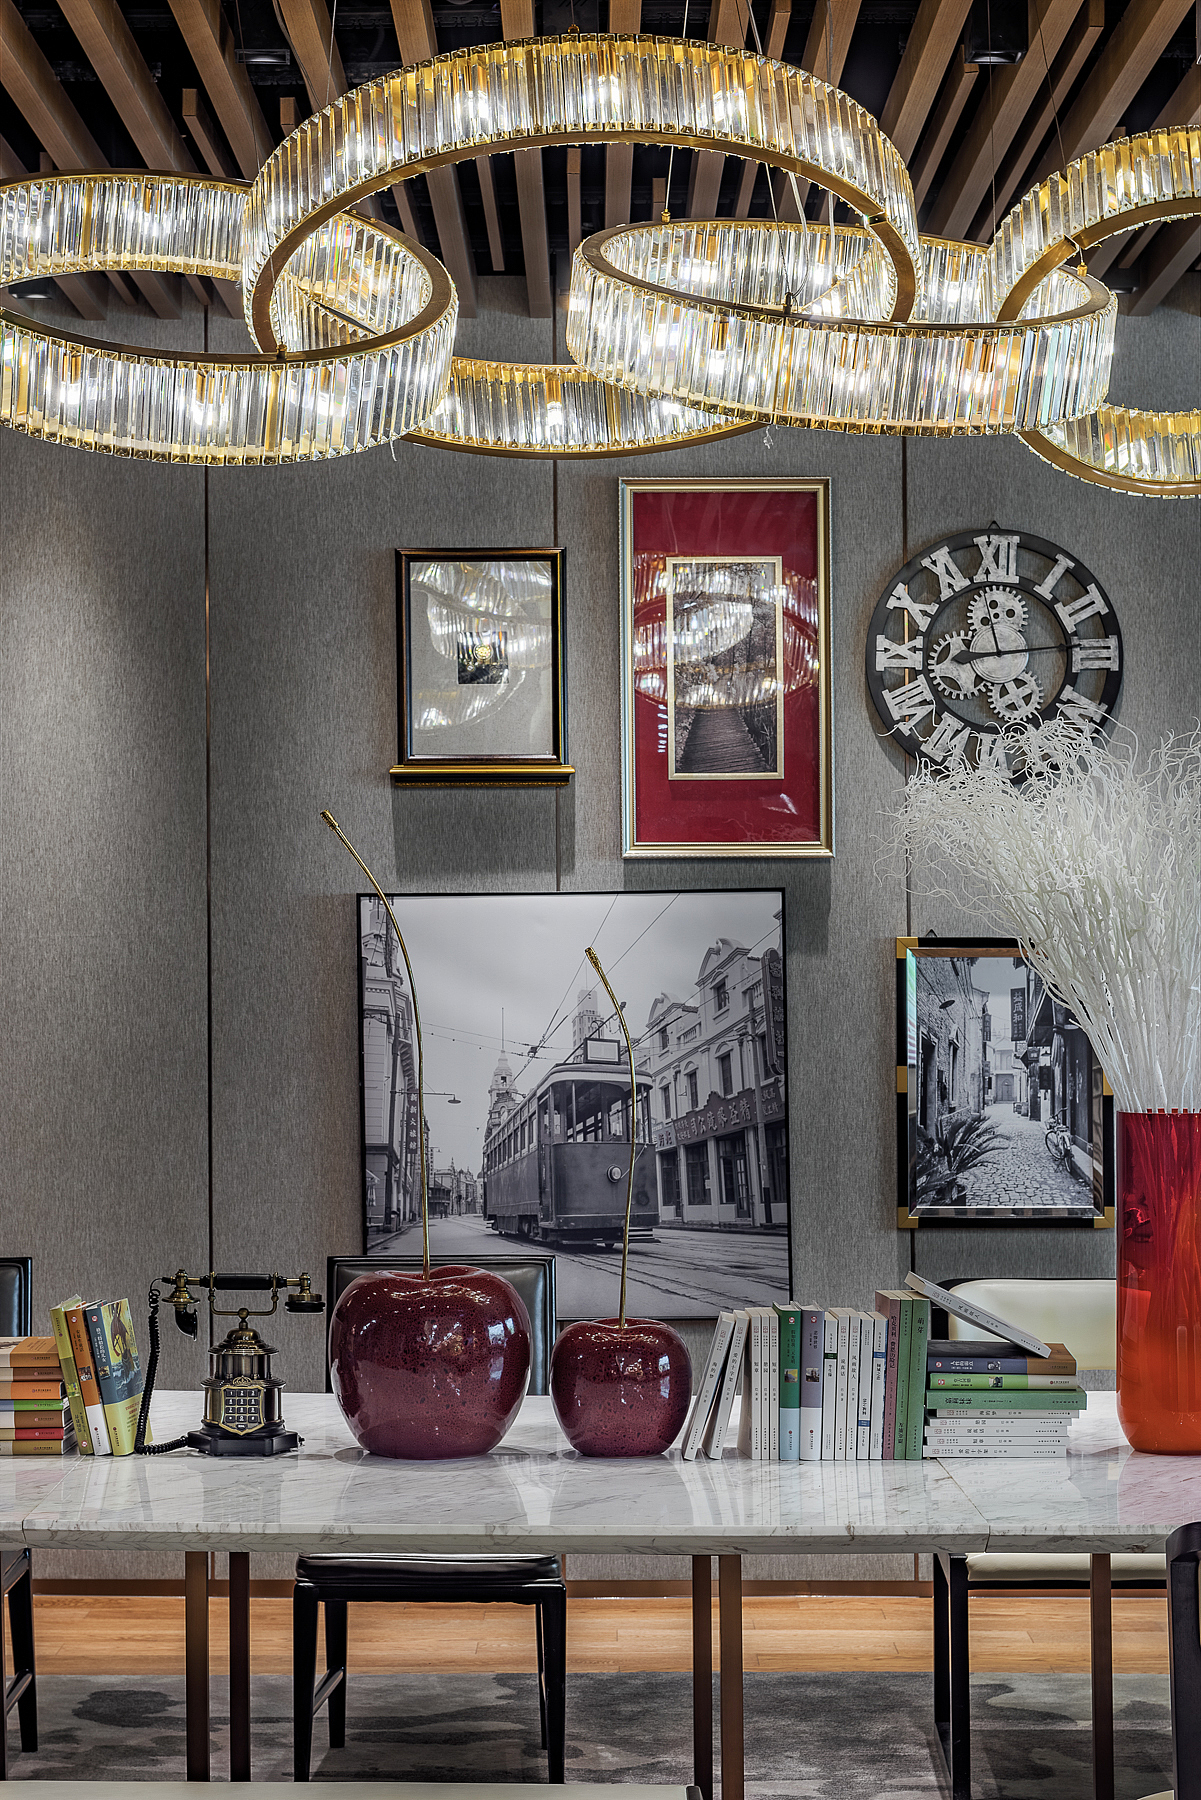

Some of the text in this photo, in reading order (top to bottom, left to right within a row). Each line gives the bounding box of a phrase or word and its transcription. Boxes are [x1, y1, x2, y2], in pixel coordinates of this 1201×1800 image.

[921, 546, 971, 601] XI
[973, 535, 1021, 583] XII
[1033, 553, 1075, 600] I
[886, 582, 939, 632] X
[1054, 583, 1109, 634] II
[876, 635, 923, 671] IX
[1071, 635, 1119, 672] III
